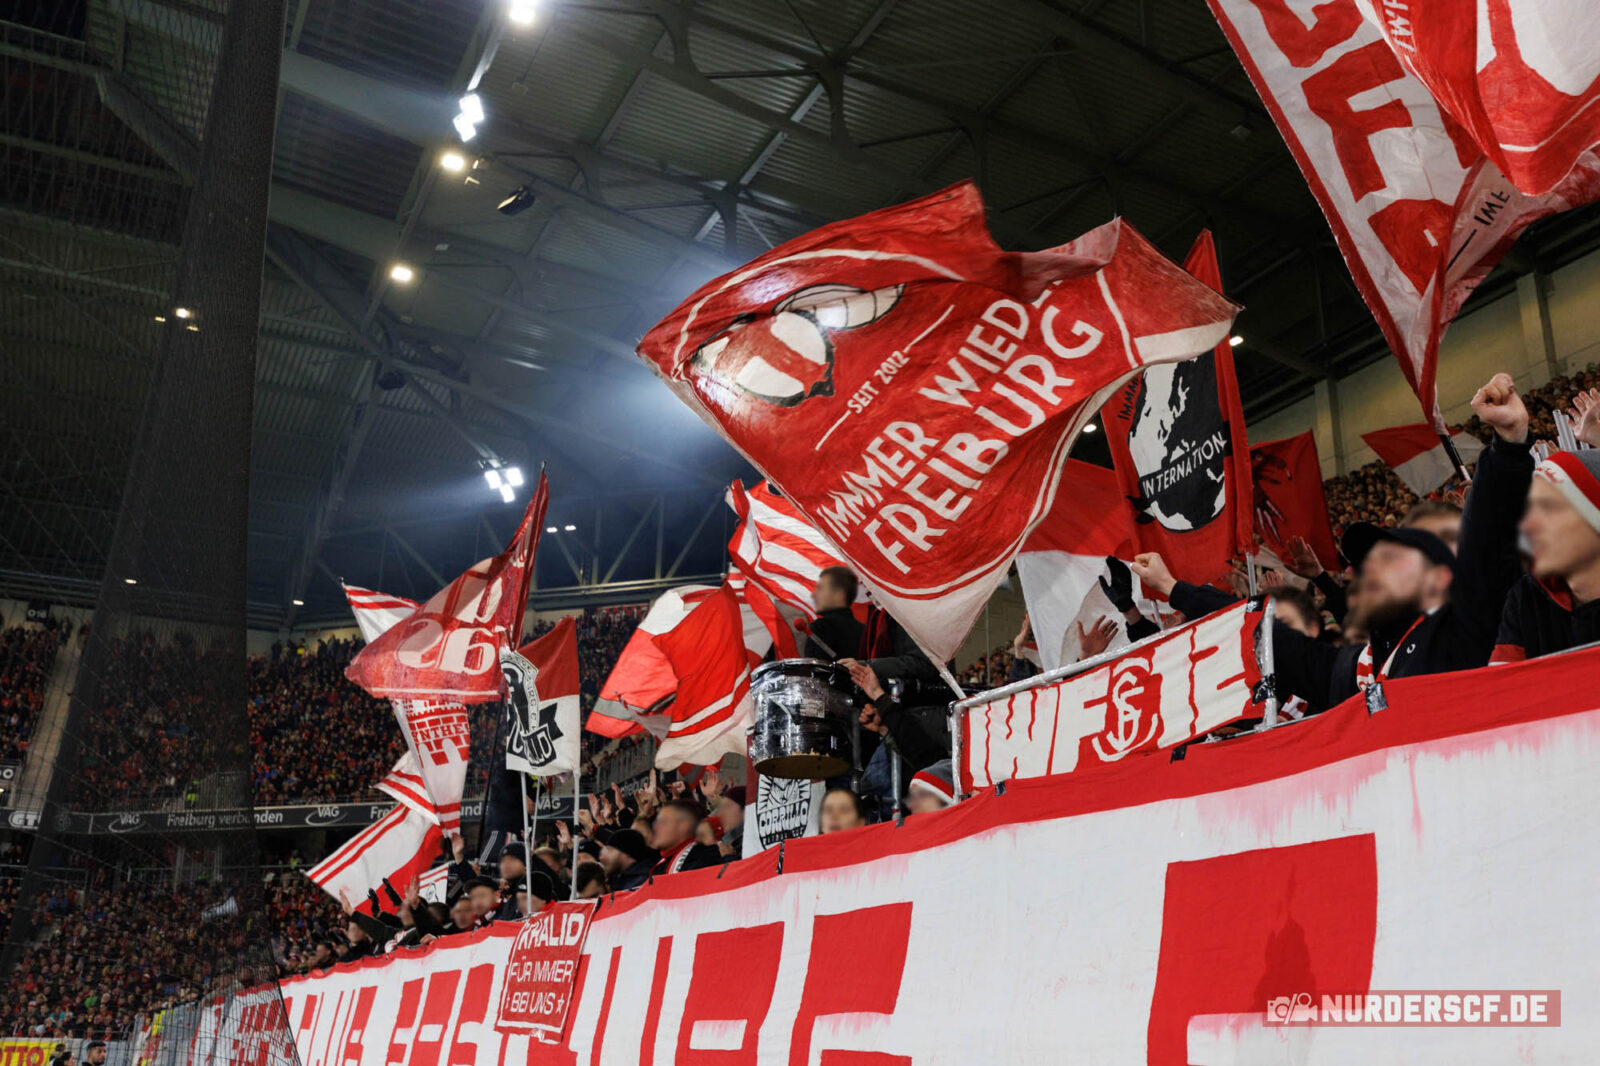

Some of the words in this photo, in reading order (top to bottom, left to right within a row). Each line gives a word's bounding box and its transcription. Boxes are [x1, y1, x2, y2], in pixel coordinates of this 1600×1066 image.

[846, 381, 879, 414] SEIT
[874, 350, 910, 385] 2012
[816, 420, 940, 543] IMMER
[919, 280, 1064, 409] WIED
[862, 302, 1104, 575] FREIBURG
[120, 813, 140, 825] VAG
[166, 813, 216, 829] Freiburg
[317, 806, 341, 818] VAG
[517, 913, 585, 950] KHALID
[510, 956, 532, 982] FÜR
[532, 960, 573, 983] IMMER
[510, 992, 530, 1013] BEI
[529, 992, 556, 1015] UNS
